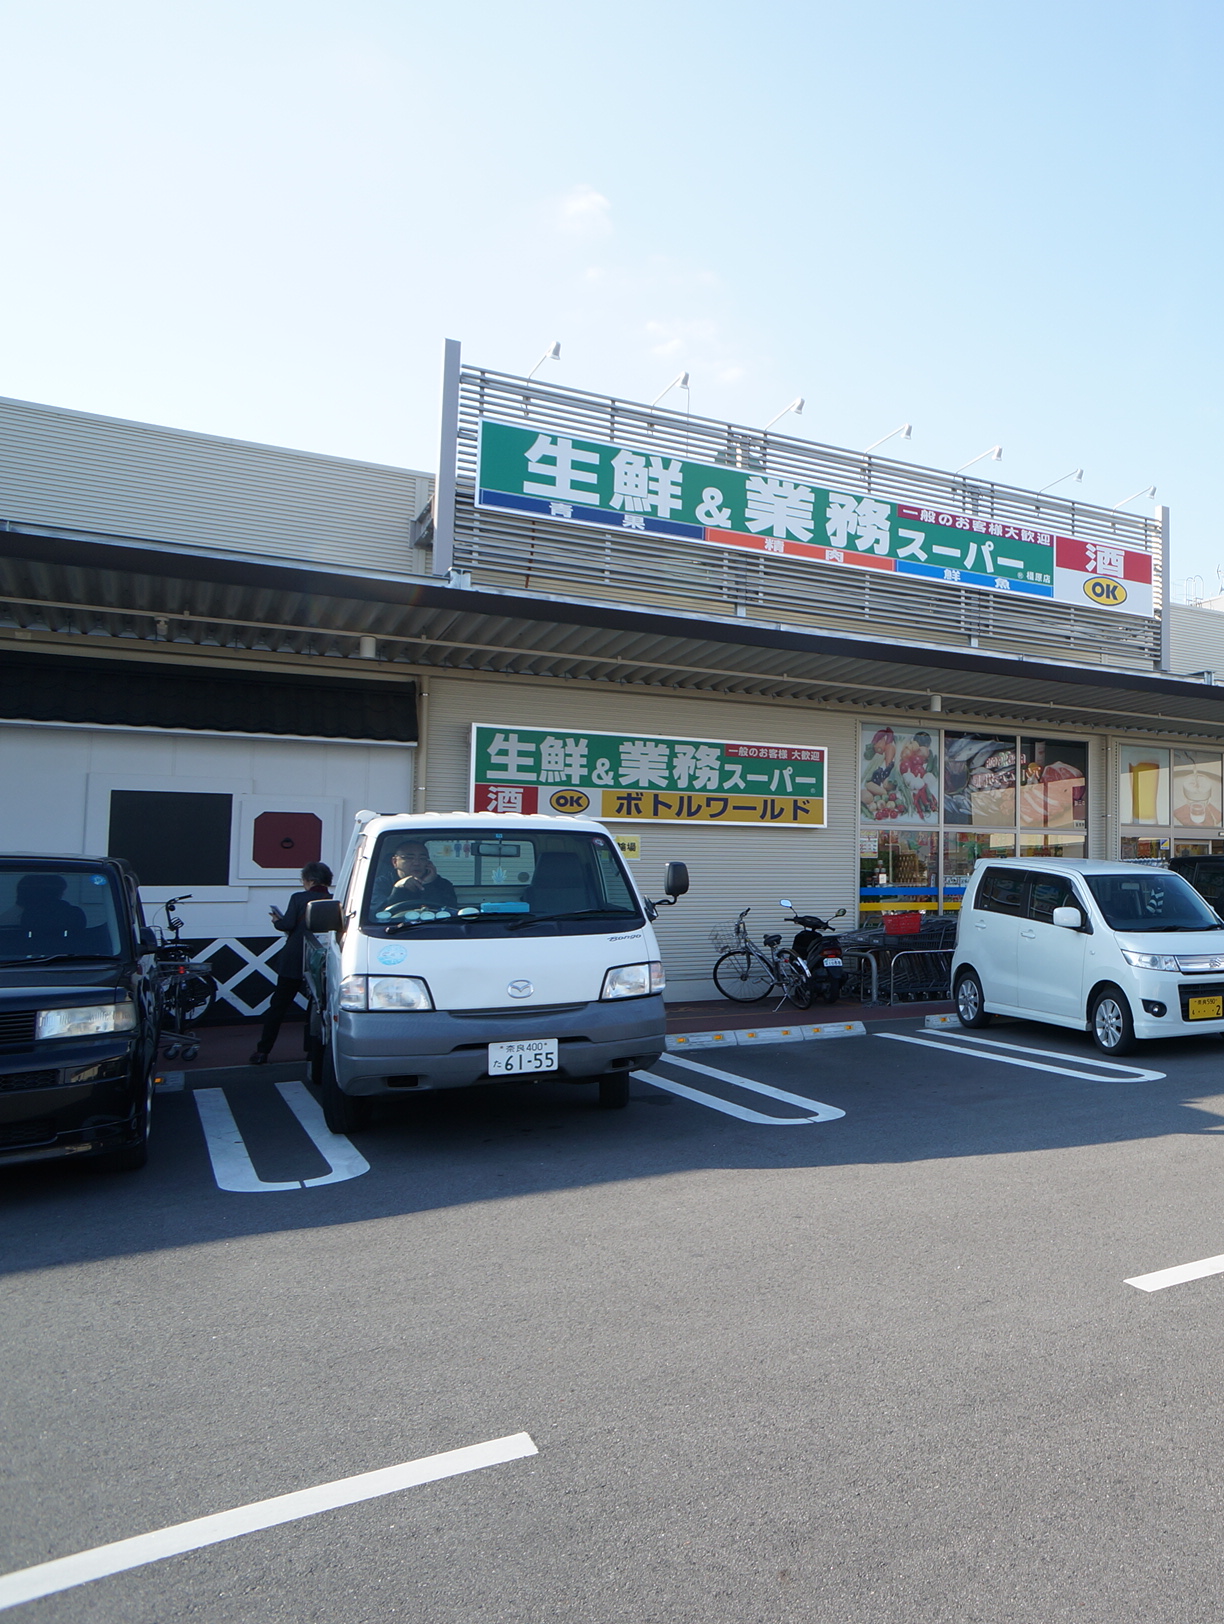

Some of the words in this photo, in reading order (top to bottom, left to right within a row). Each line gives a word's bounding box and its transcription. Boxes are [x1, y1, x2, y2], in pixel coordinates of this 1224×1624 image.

[902, 508, 1051, 546] 一般のお客様大歓迎
[1085, 542, 1125, 578] 酒
[1091, 581, 1118, 600] OK
[728, 746, 788, 760] 一般のお客様
[791, 750, 821, 762] 大歓迎
[486, 785, 524, 813] 酒
[555, 795, 584, 808] OK
[615, 791, 811, 821] ボトルワールド
[505, 1052, 554, 1071] 61-55
